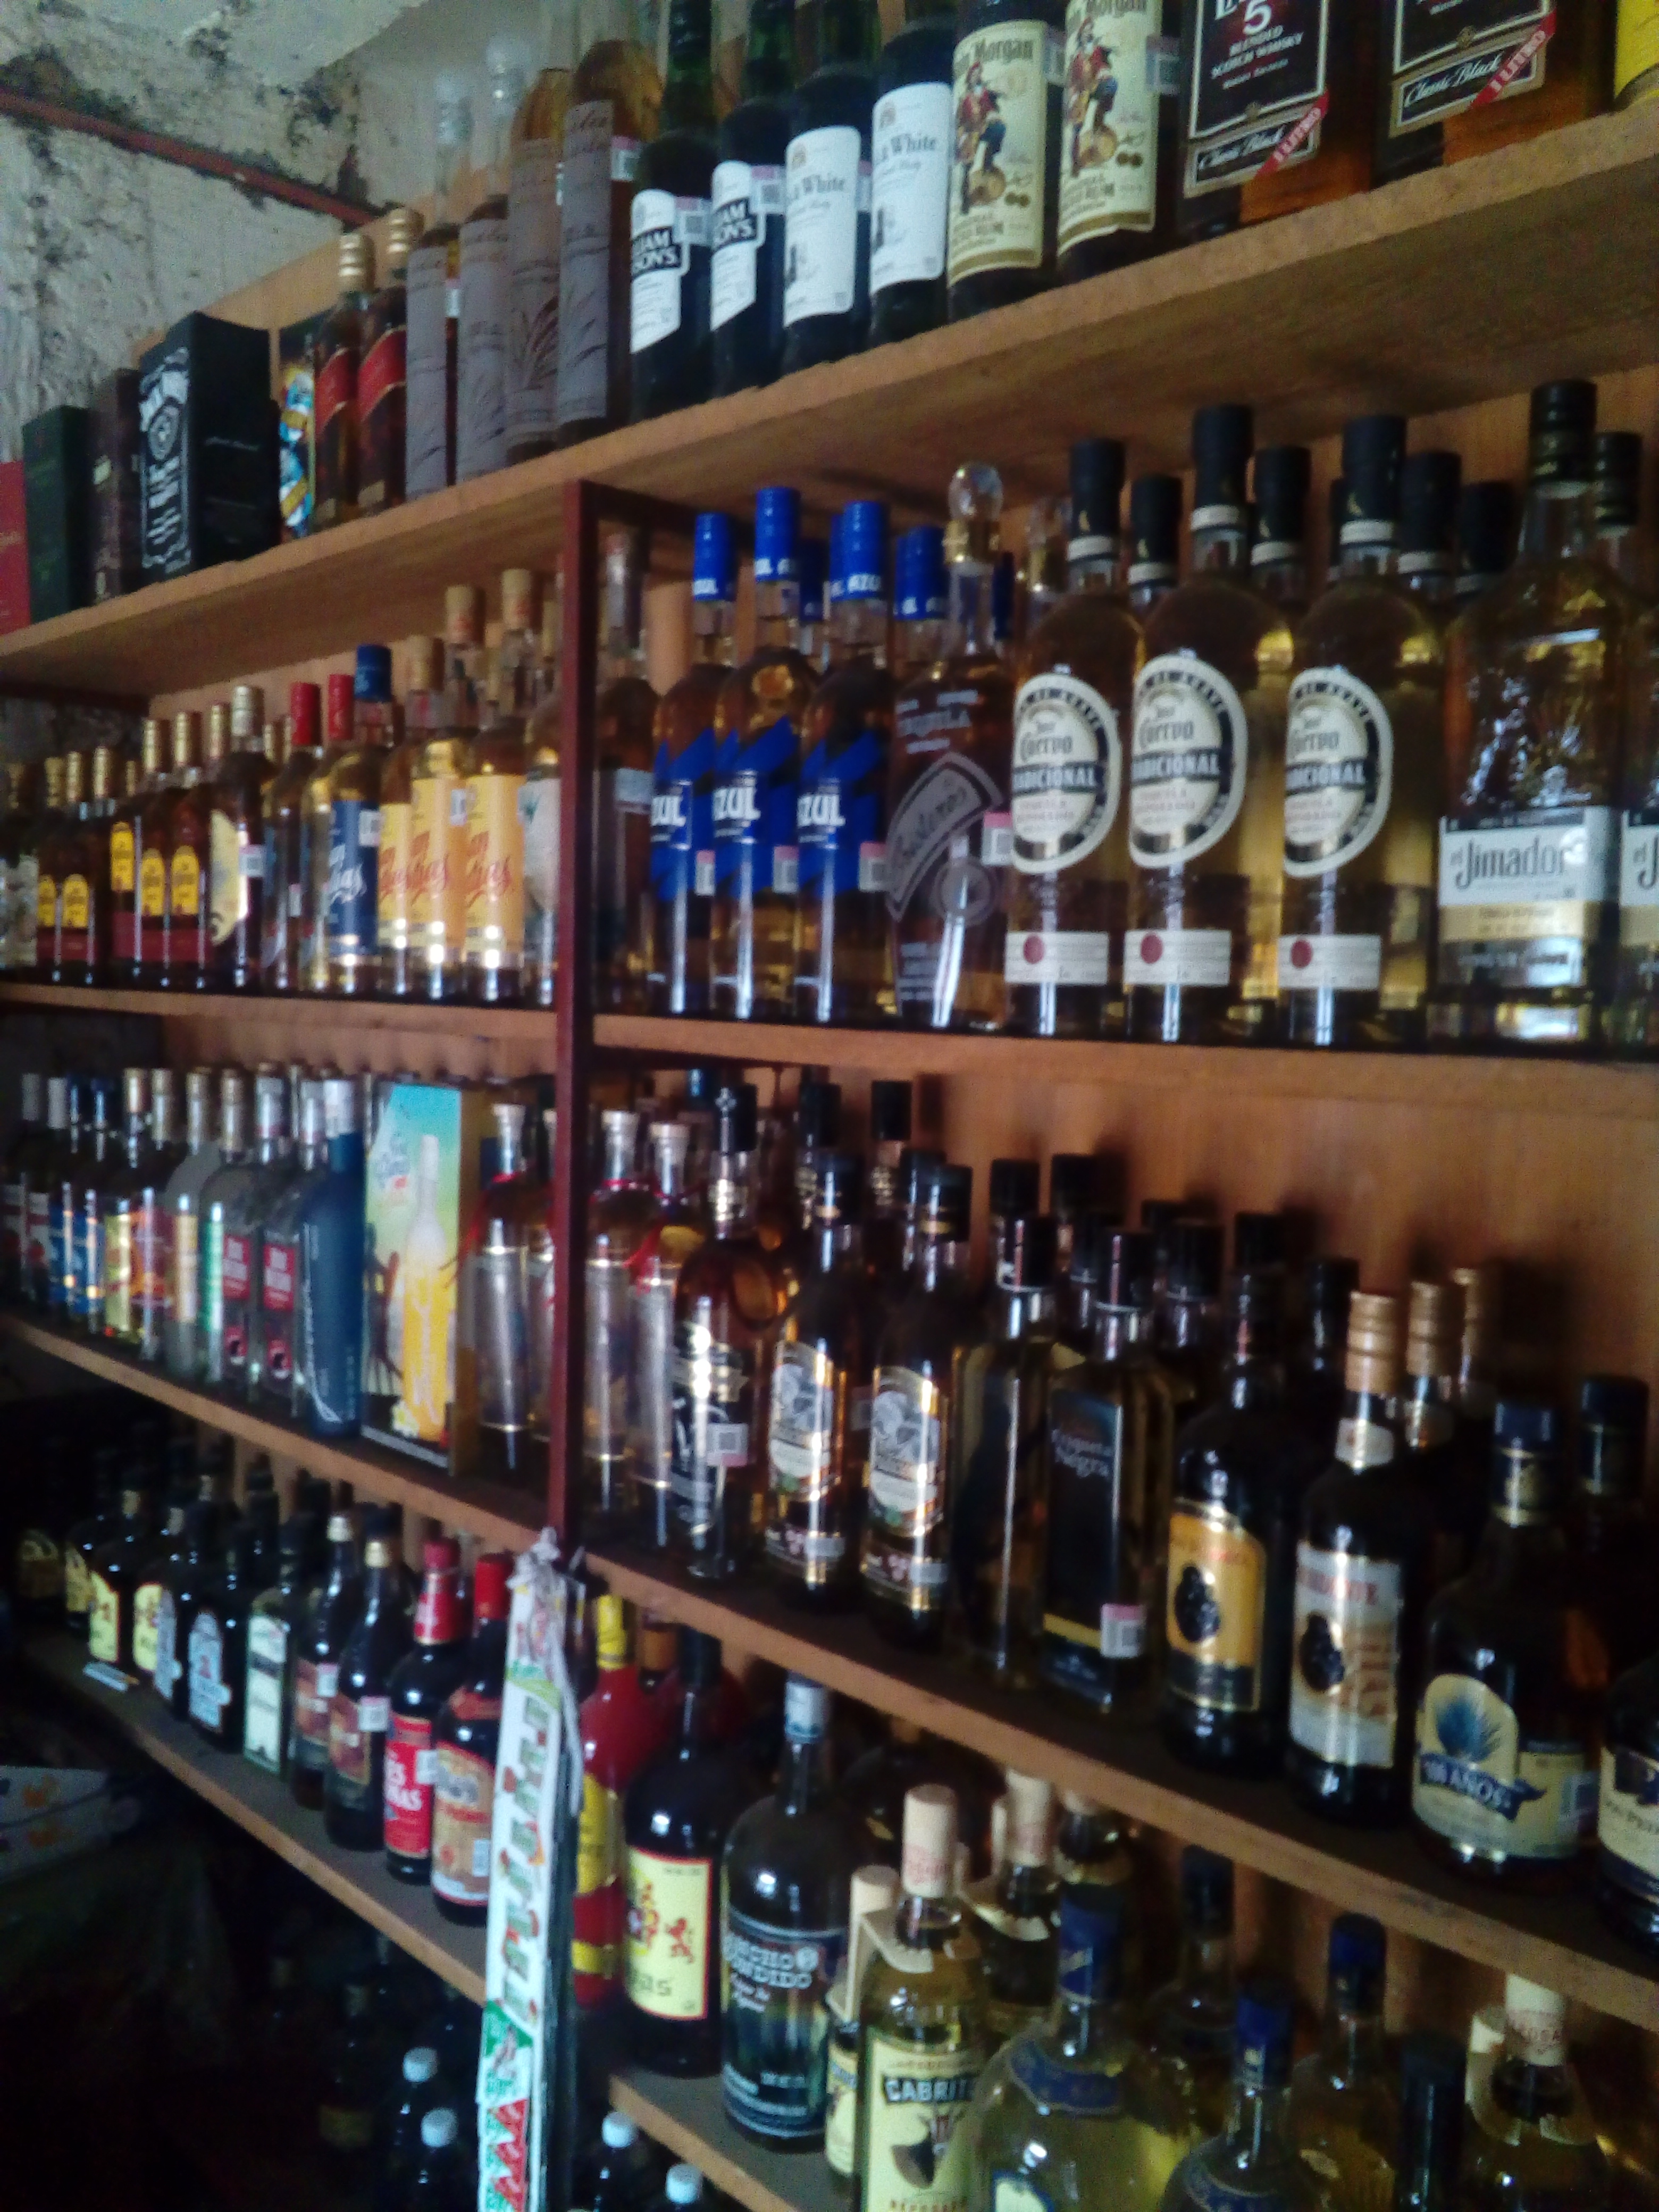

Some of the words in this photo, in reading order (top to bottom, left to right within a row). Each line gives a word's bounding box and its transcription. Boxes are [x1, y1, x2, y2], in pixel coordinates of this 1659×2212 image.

[1243, 0, 1272, 35] 5
[1254, 32, 1304, 58] WHISKY
[1451, 51, 1506, 87] Black
[891, 132, 937, 154] White
[802, 173, 845, 195] White
[1455, 836, 1564, 890] Jimador
[885, 2076, 973, 2102] CABRIT
